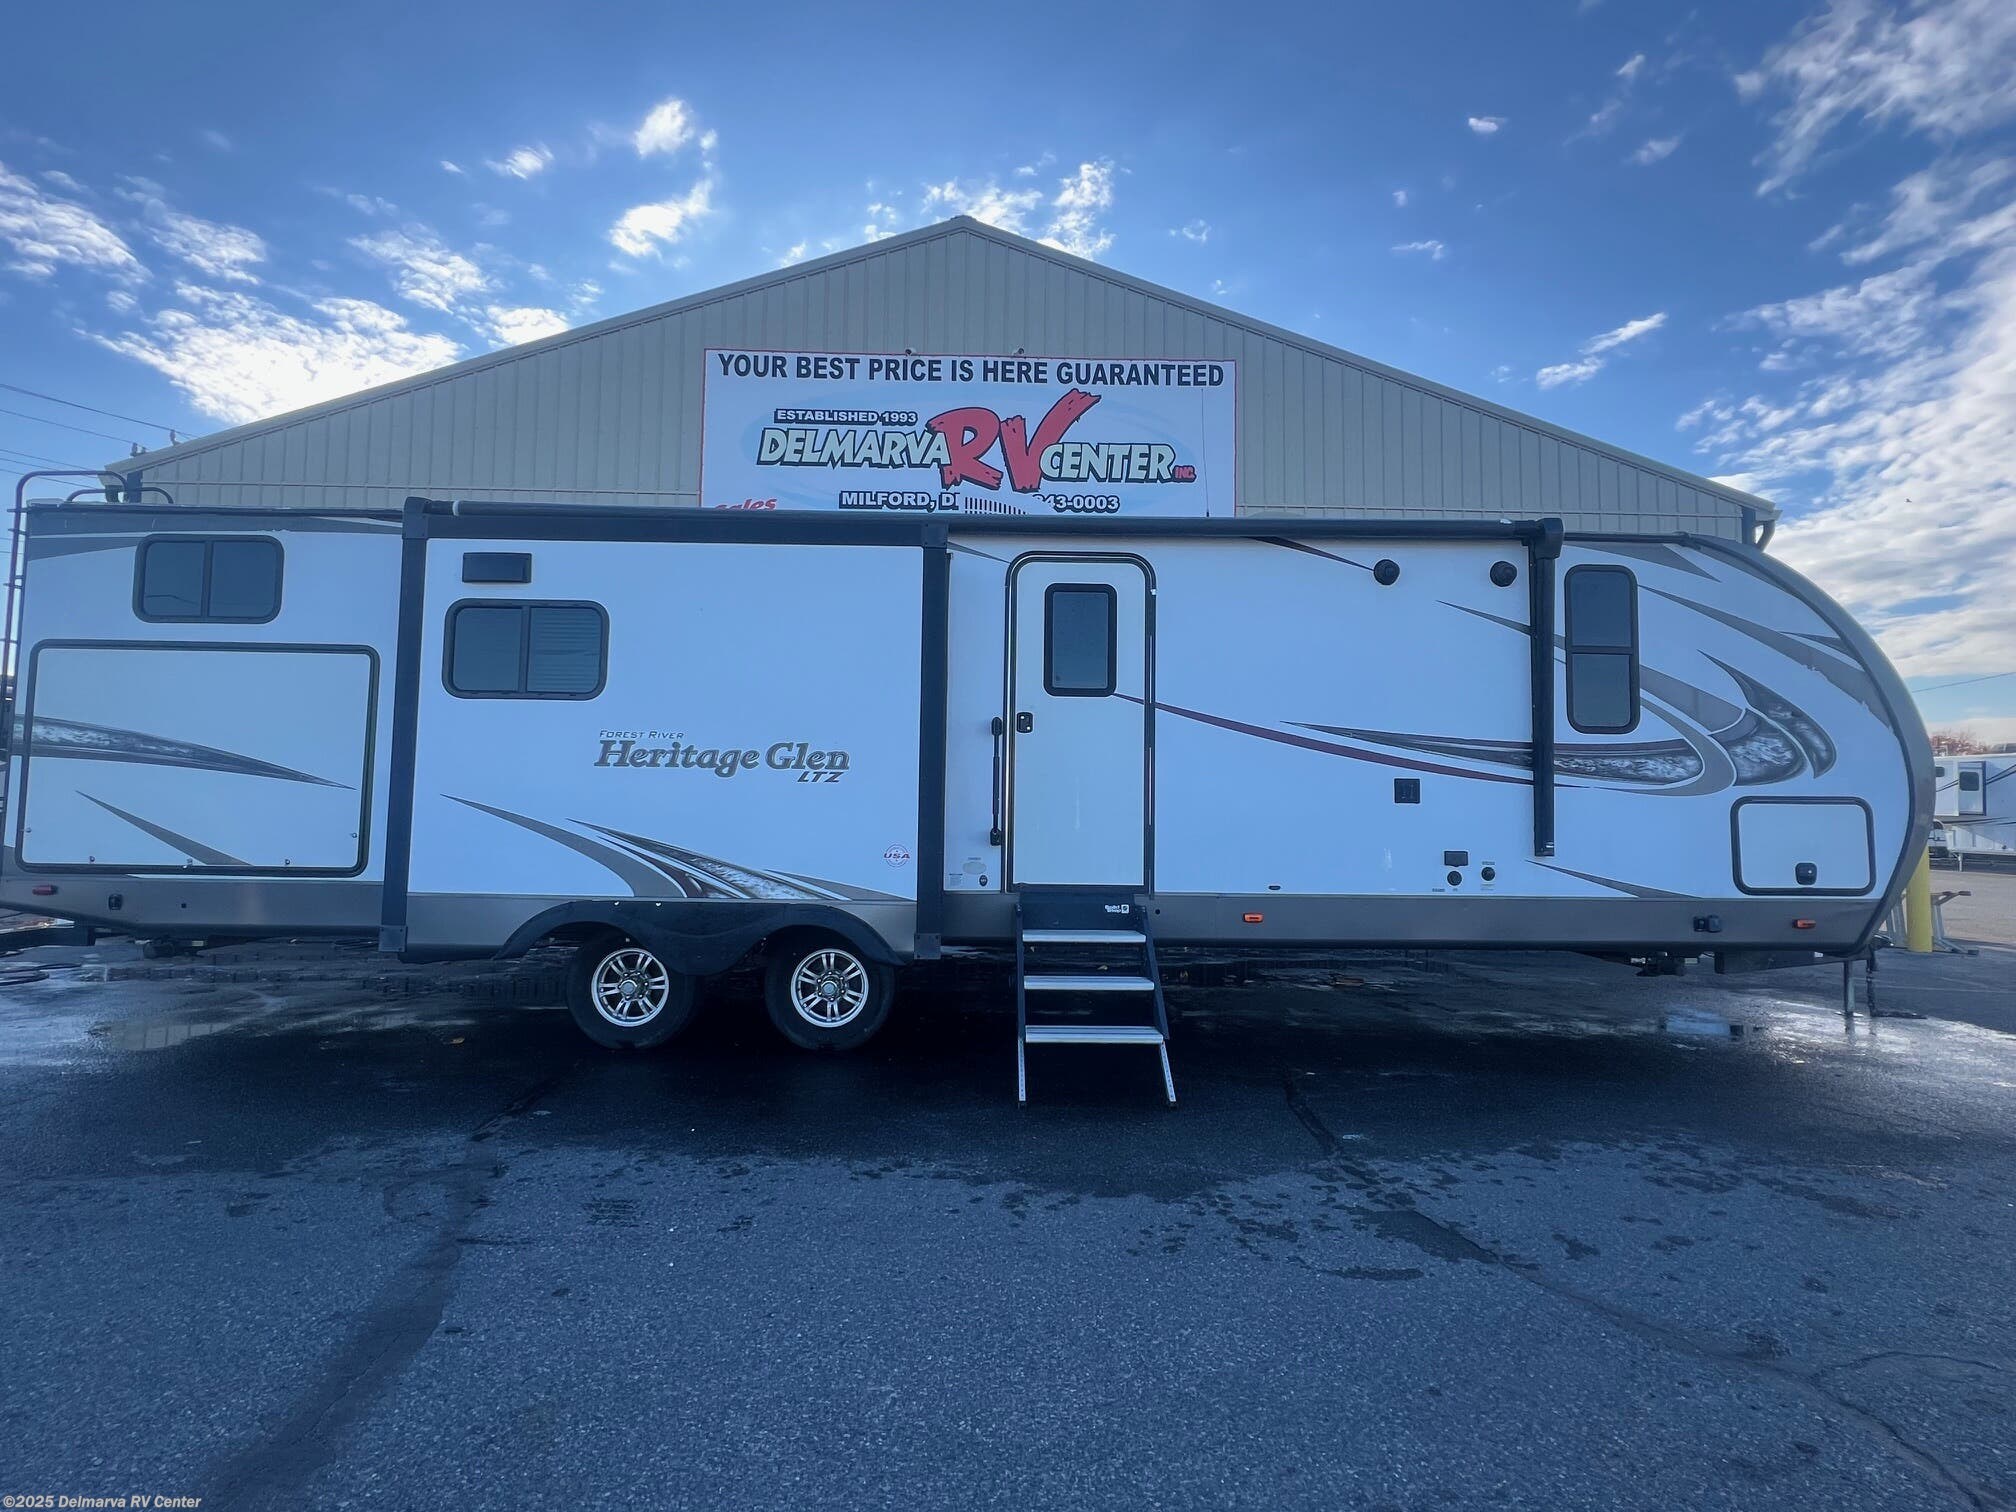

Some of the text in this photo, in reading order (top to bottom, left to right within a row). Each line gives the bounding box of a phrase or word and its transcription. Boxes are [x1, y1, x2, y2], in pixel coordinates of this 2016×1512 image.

[718, 353, 1224, 387] YOUR BEST PRICE IS HERE GUARANTEED
[775, 409, 918, 424] ESTABLISHED 1993
[758, 428, 952, 468] DELMARVA
[926, 388, 1101, 493] RV
[1040, 442, 1176, 483] CENTER
[840, 491, 936, 510] MILFORD,
[599, 730, 685, 739] FOREST RIVER
[594, 740, 850, 778] Heritage Glen
[797, 771, 844, 783] LTZ
